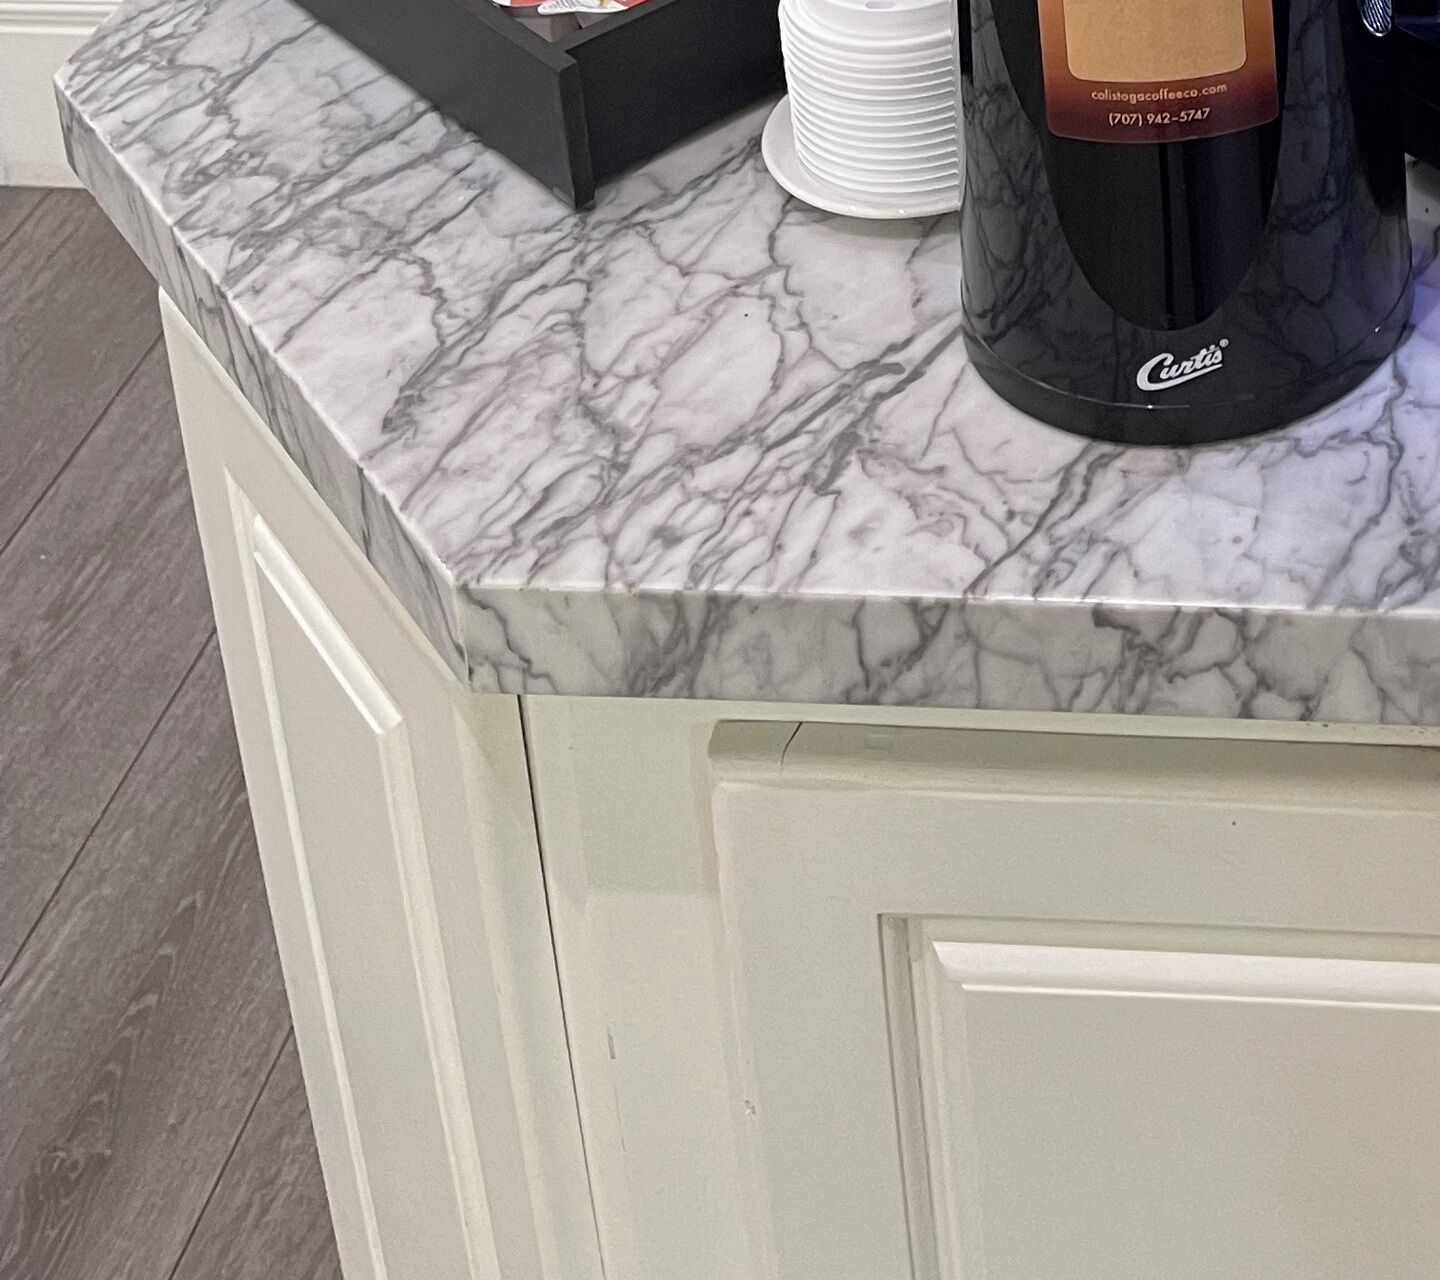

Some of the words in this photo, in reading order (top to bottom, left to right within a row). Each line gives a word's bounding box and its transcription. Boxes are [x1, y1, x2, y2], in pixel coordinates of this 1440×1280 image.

[1091, 82, 1228, 104] calistogacoffeeco.com
[1108, 112, 1143, 127] (707)
[1146, 107, 1211, 126] 942-5747
[1136, 343, 1224, 392] Curtis
